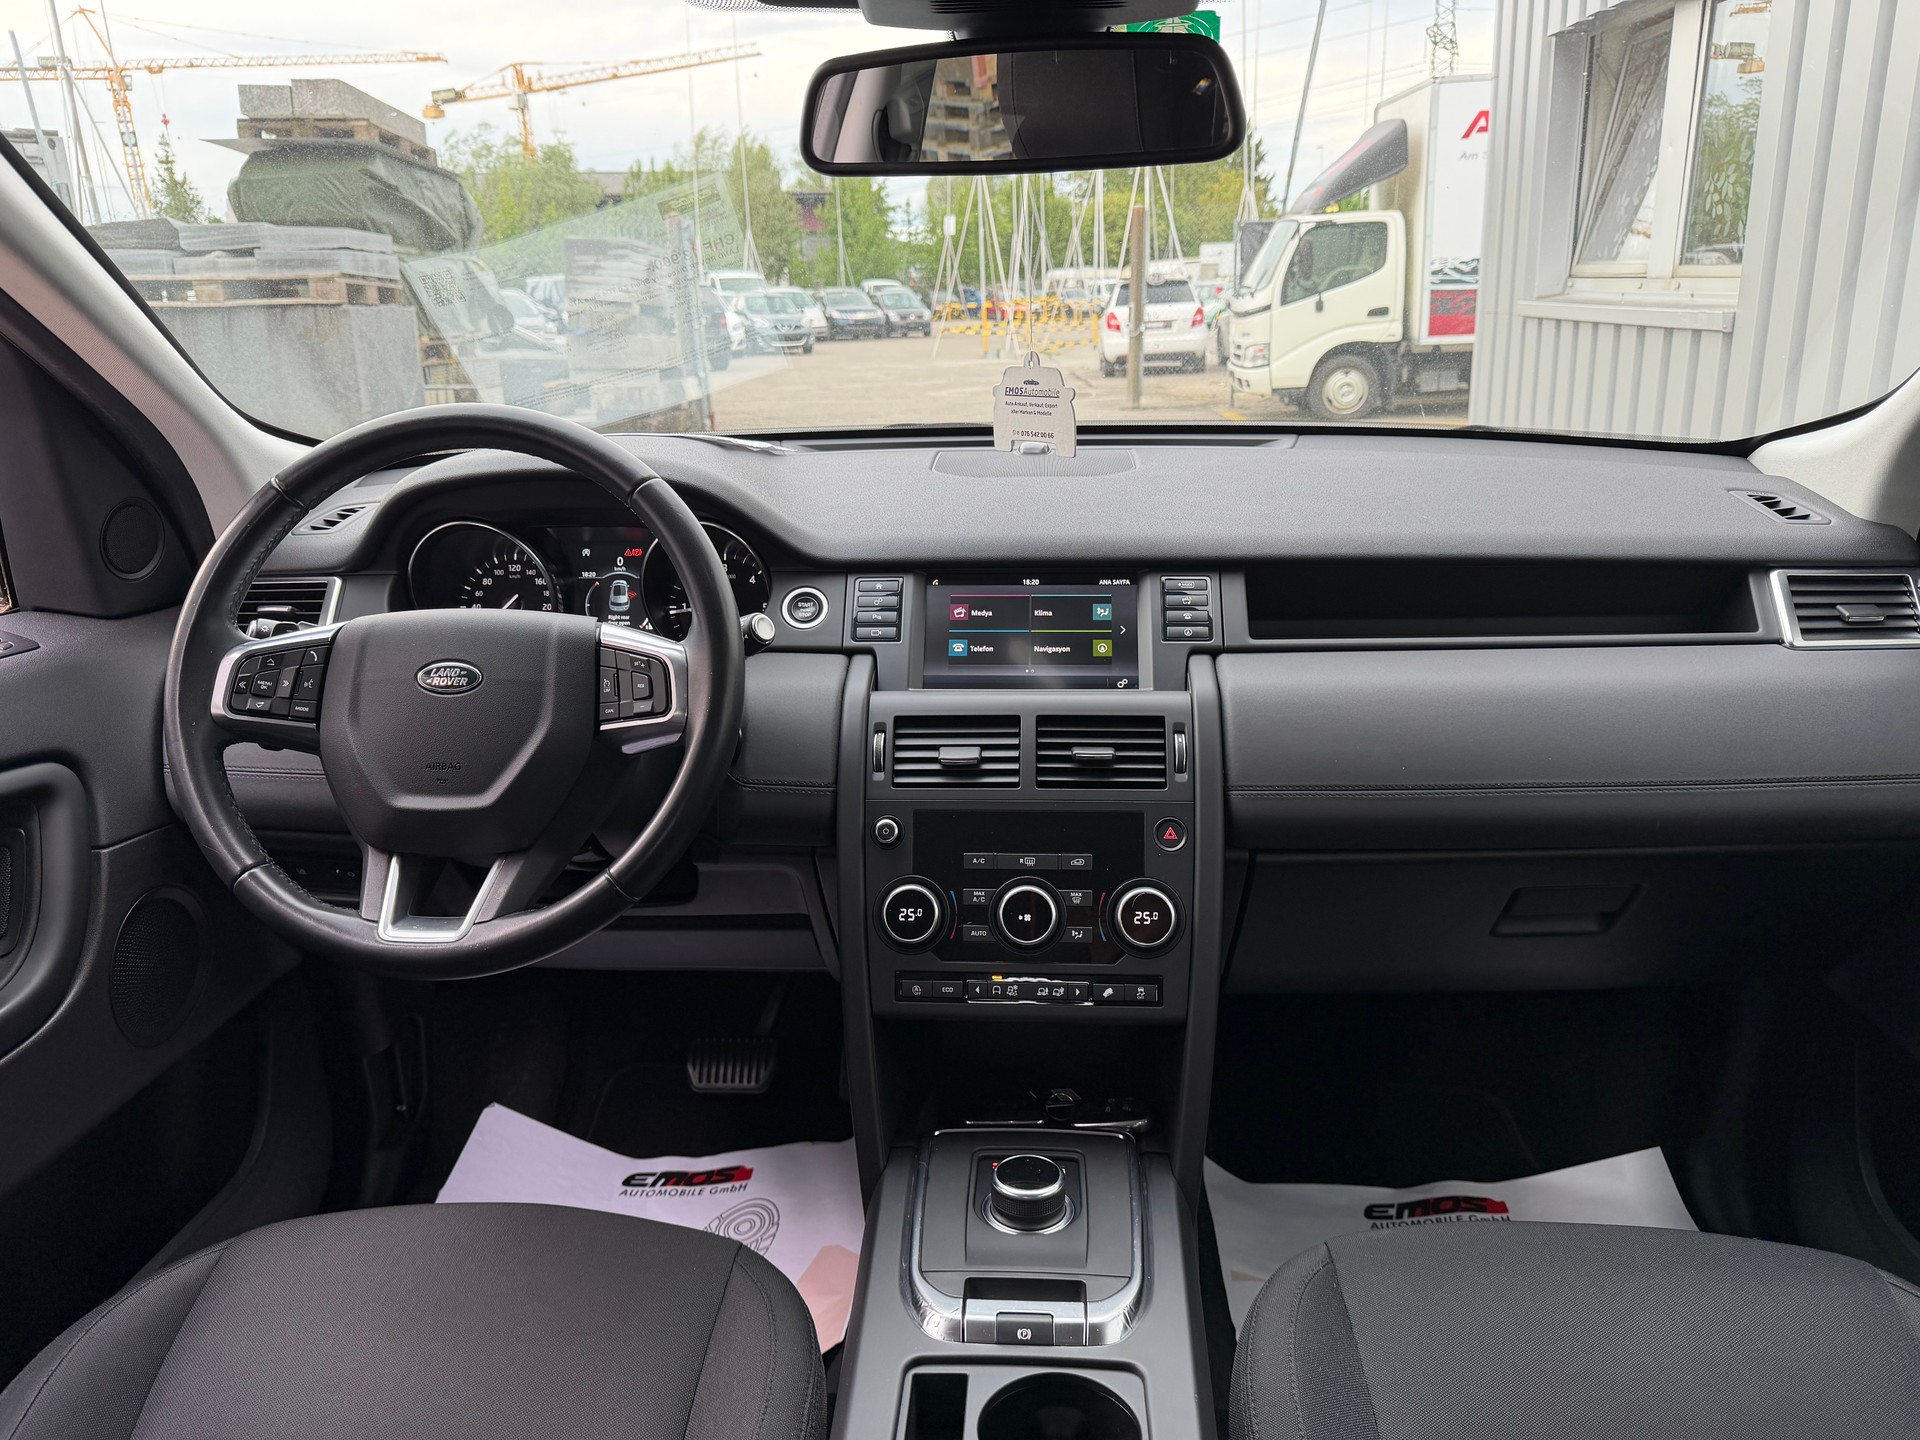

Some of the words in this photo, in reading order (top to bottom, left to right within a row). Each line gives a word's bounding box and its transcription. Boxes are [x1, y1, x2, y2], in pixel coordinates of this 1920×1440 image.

[617, 557, 624, 566] 0
[508, 564, 521, 572] 120
[749, 575, 756, 584] 4
[1022, 578, 1040, 586] 18:20
[542, 603, 552, 611] 20
[971, 609, 993, 618] Medya
[1034, 608, 1053, 617] Klima
[970, 644, 994, 653] Telefon
[1034, 644, 1071, 655] Navigasyon
[430, 668, 460, 677] LAND
[431, 677, 468, 686] ROVER
[425, 762, 461, 771] AIRBAG
[898, 908, 923, 922] 25.0
[1134, 911, 1159, 925] 25.0
[621, 1165, 745, 1188] EMOS
[619, 1187, 706, 1198] AUTOMOBILE
[709, 1182, 748, 1196] GmbH
[1363, 1195, 1490, 1221] EMOS
